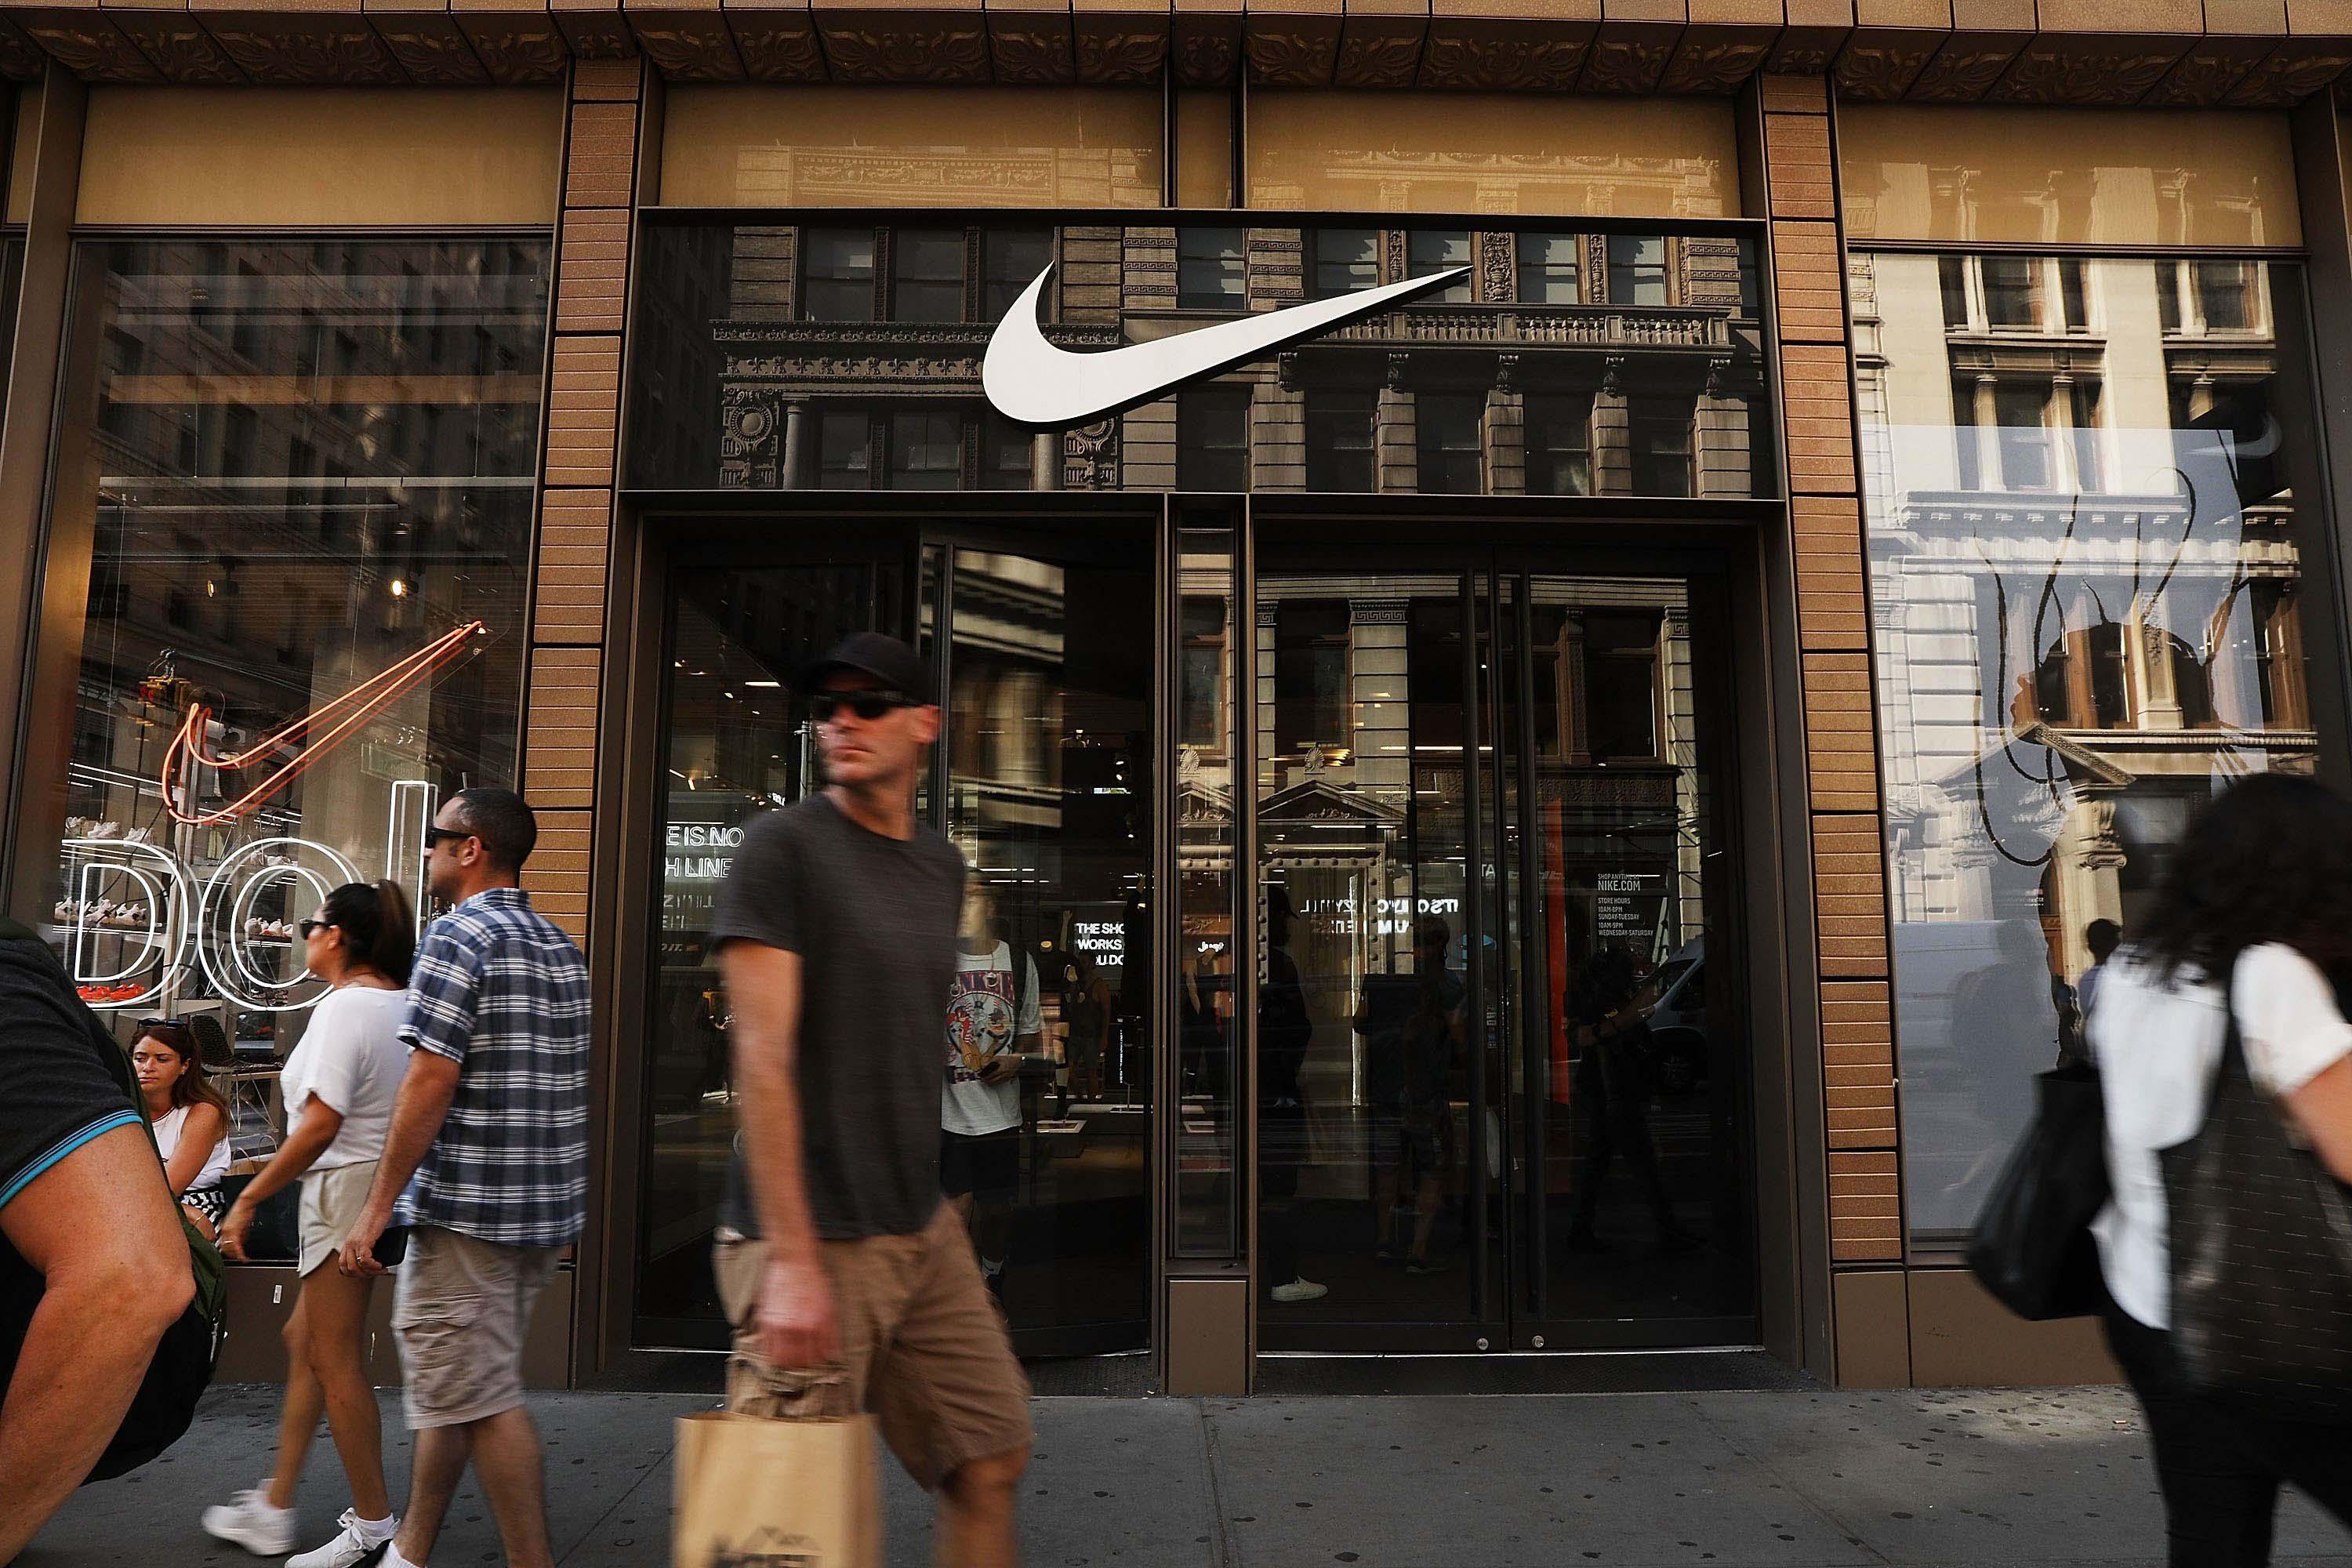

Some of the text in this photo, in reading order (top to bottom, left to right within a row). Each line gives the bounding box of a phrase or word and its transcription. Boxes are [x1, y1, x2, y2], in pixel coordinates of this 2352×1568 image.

[684, 826, 704, 846] IS
[710, 826, 745, 848] NO
[685, 857, 734, 878] LINE
[1598, 880, 1640, 891] NIKE.COM
[1076, 923, 1100, 934] THE
[1077, 938, 1123, 950] WORKS
